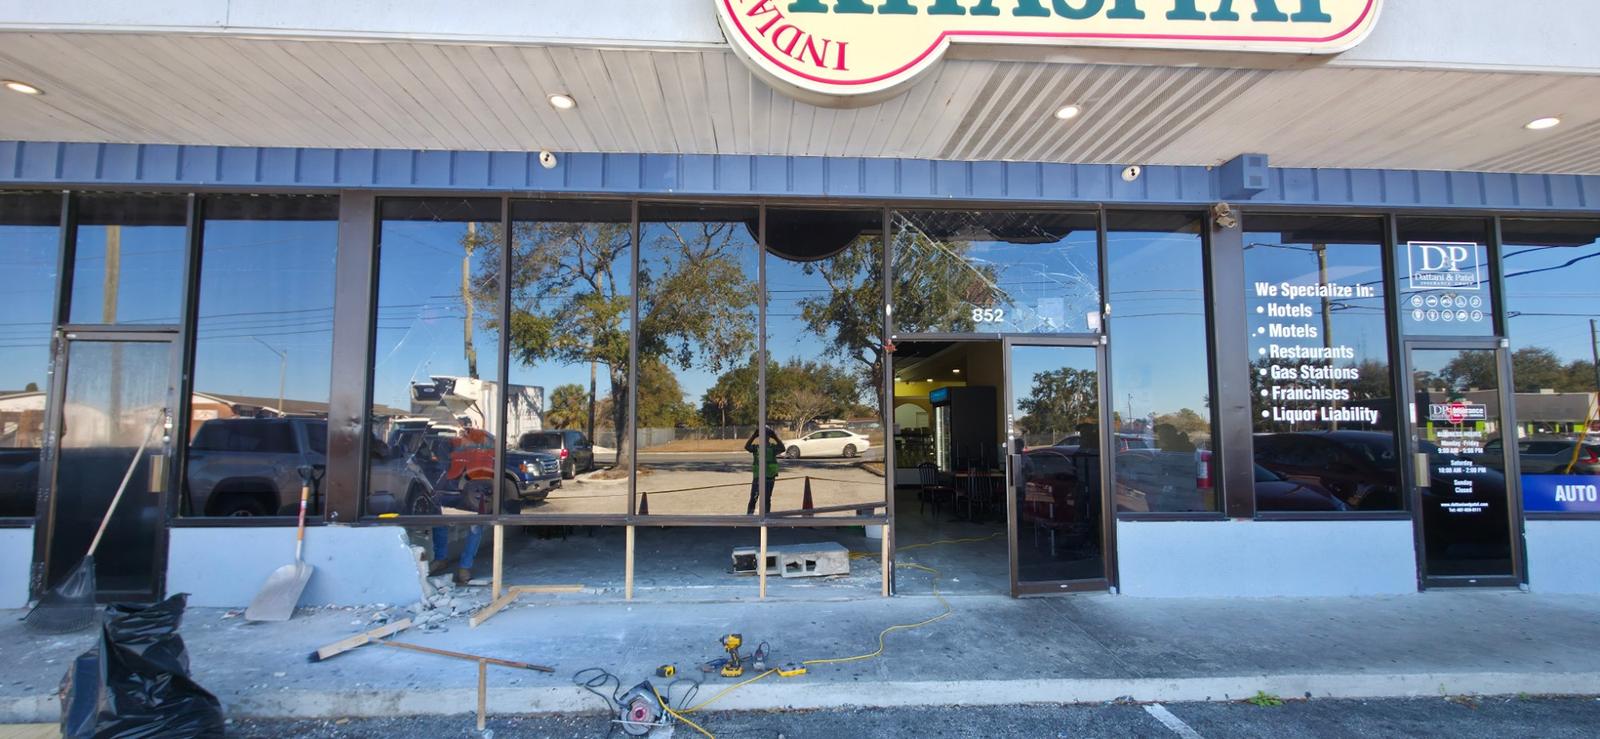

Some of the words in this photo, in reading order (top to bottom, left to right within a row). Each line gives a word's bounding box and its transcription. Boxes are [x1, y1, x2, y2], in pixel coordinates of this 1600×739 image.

[740, 0, 849, 71] INDIA
[1255, 282, 1277, 297] We
[1281, 282, 1352, 299] Specialize
[1356, 283, 1375, 297] in:
[972, 309, 1004, 322] 852
[1267, 303, 1313, 317] Hotels
[1268, 324, 1318, 338] Motels
[1269, 344, 1354, 359] Restaurants
[1270, 365, 1297, 380] Gas
[1300, 364, 1359, 380] Stations
[1271, 385, 1350, 400] Franchises
[1273, 407, 1318, 424] Liquor
[1320, 407, 1379, 424] Liability
[1555, 484, 1597, 502] AUTO
